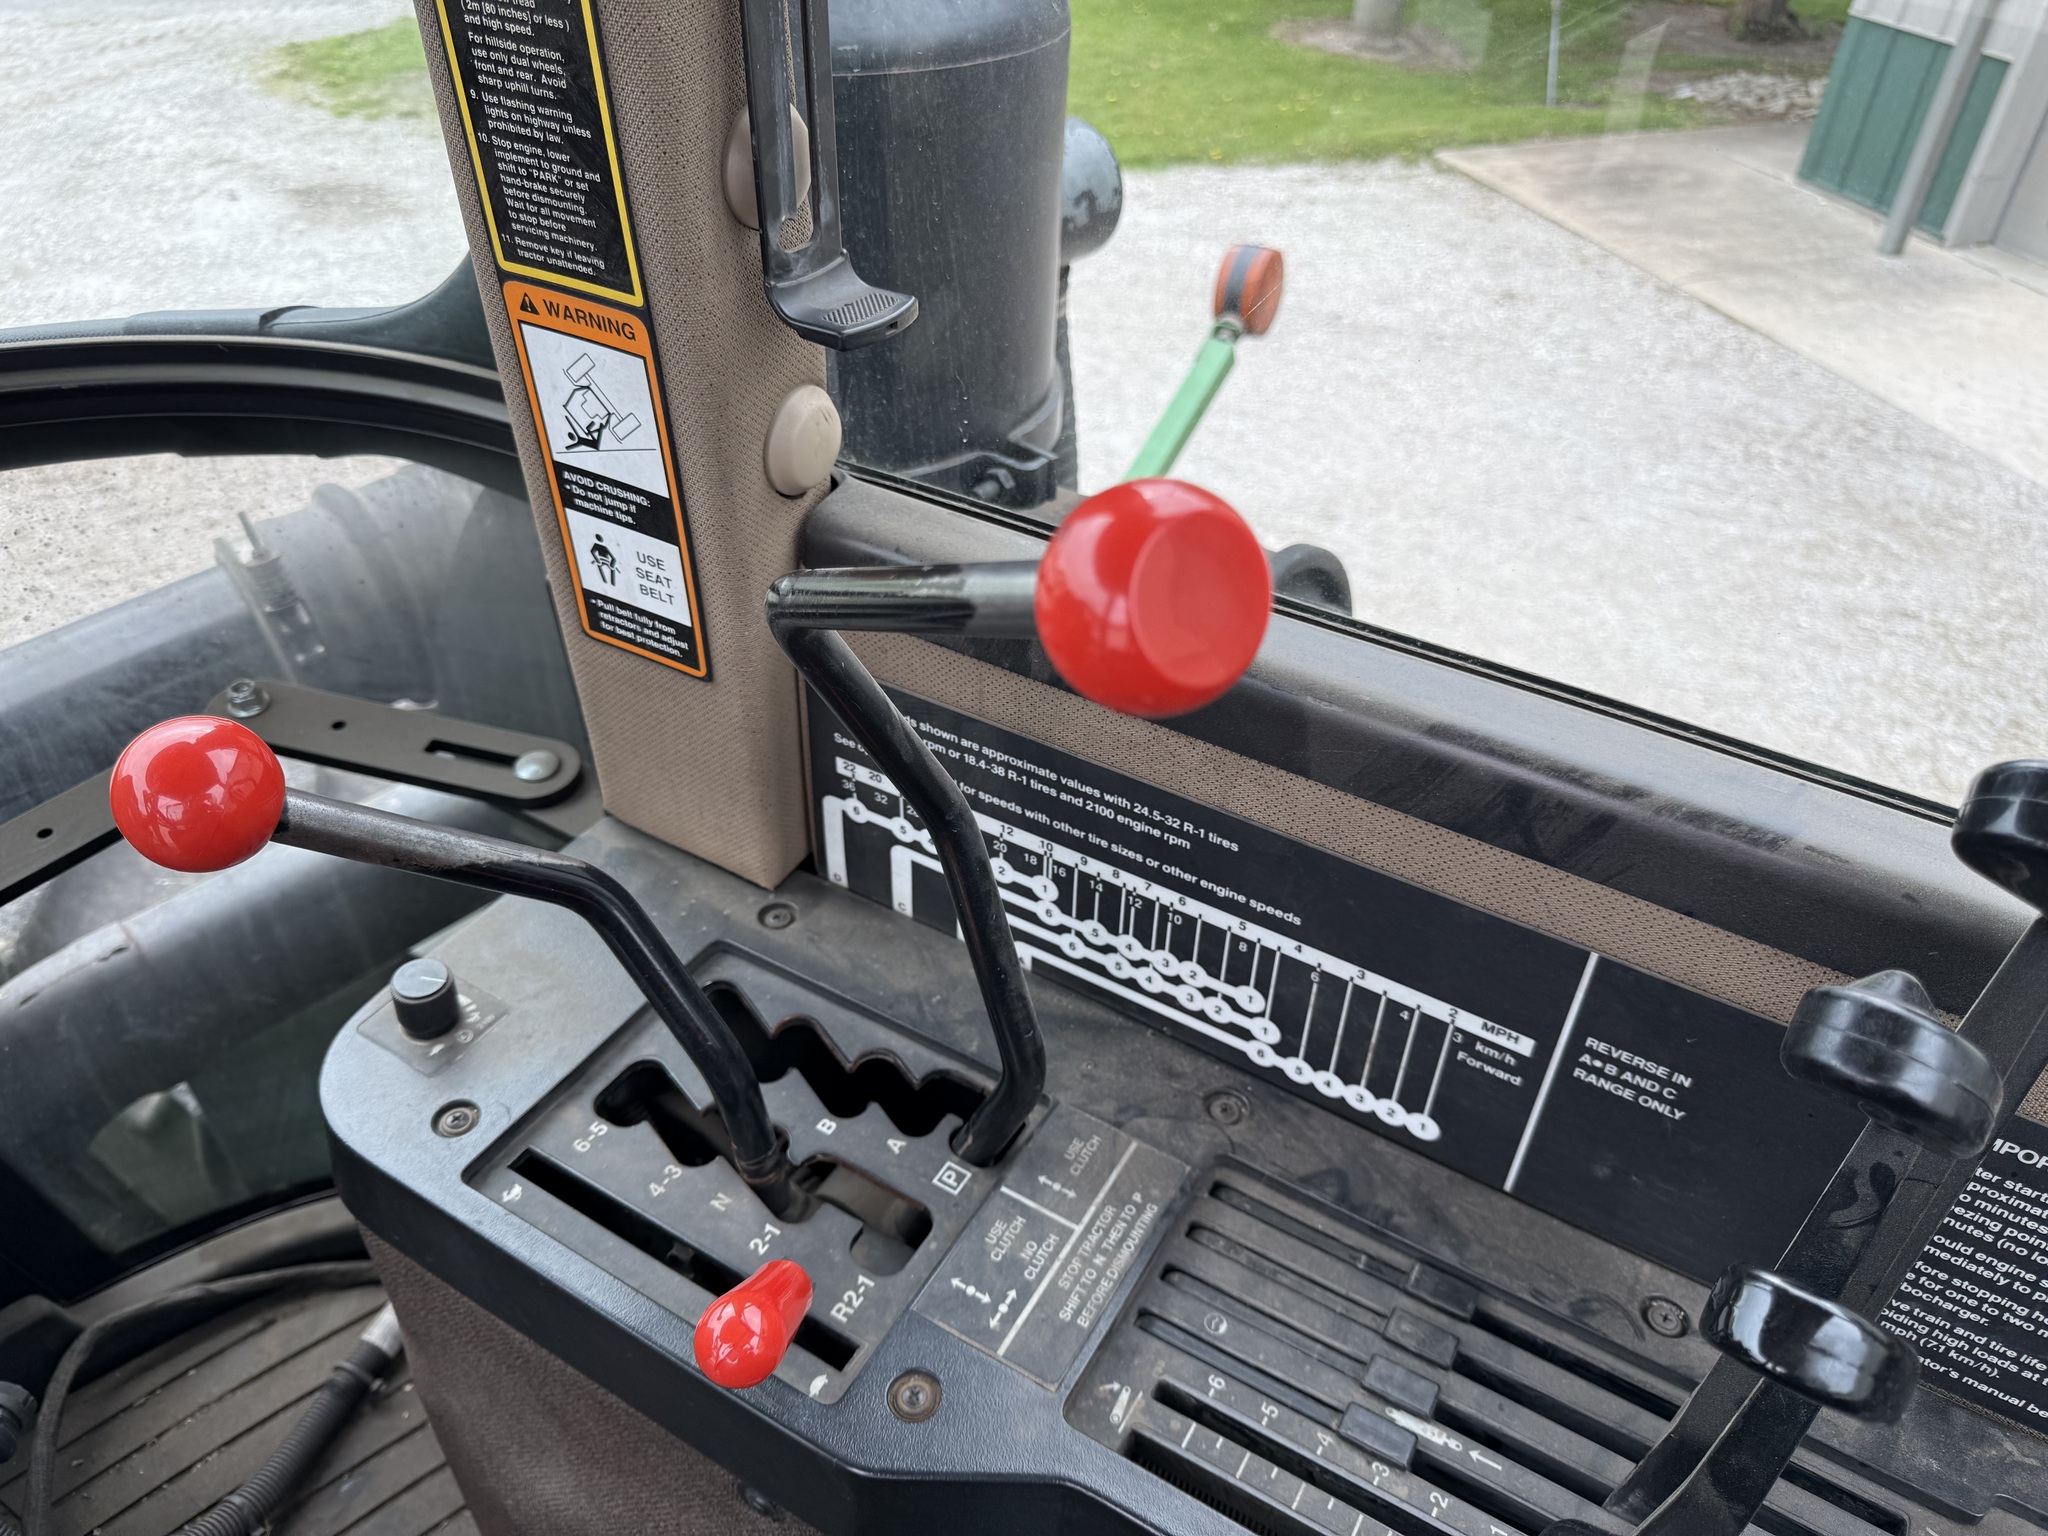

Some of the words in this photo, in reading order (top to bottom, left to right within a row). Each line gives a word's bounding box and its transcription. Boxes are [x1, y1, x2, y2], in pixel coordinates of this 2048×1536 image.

[504, 22, 534, 36] speed.
[468, 32, 483, 42] For
[485, 35, 517, 51] hillside
[520, 44, 564, 63] operation,
[531, 85, 557, 99] turns.
[542, 74, 566, 88] Avoid
[470, 89, 478, 99] 9.
[482, 92, 498, 103] Use
[500, 96, 535, 114] flashing
[537, 106, 572, 123] warning
[485, 105, 509, 119] lights
[524, 115, 559, 132] highway
[563, 125, 591, 138] unless
[488, 119, 531, 136] prohibited
[478, 132, 490, 143] 10.
[492, 135, 512, 149] Stop
[514, 142, 545, 157] engine,
[547, 149, 570, 162] lower
[500, 173, 547, 193] hand-brake
[529, 168, 561, 183] "PARK"
[505, 197, 524, 210] Wait
[552, 211, 596, 228] movement
[532, 193, 587, 215] dismounting.
[501, 234, 513, 243] 11.
[515, 236, 548, 252] Remove
[574, 252, 605, 269] leaving
[552, 232, 597, 251] machinery.
[517, 249, 545, 262] tractor
[547, 256, 596, 276] unattended.
[543, 299, 636, 341] WARNING
[563, 471, 594, 488] AVOID
[596, 481, 651, 507] CRUSHING:
[572, 486, 586, 497] Do
[588, 490, 603, 502] not
[605, 494, 628, 513] jump
[630, 503, 637, 513] if
[575, 498, 614, 518] machine
[616, 510, 636, 524] tips.
[636, 551, 665, 571] USE
[635, 567, 672, 589] SEAT
[639, 584, 675, 605] BELT
[597, 599, 614, 613] Pull
[616, 605, 633, 619] belt
[634, 612, 653, 627] fully
[655, 620, 676, 635] from
[598, 612, 642, 632] retractors
[644, 628, 660, 638] and
[662, 633, 689, 650] adjust
[602, 622, 614, 632] for
[615, 625, 634, 639] best
[637, 635, 683, 657] protection.
[919, 723, 958, 743] shown
[960, 736, 979, 751] are
[981, 746, 1058, 781] approximate
[1060, 774, 1101, 798] values
[1103, 790, 1132, 810] with
[1133, 802, 1181, 830] 24.5-32
[1183, 819, 1205, 837] R-1
[1208, 828, 1239, 852] tires
[948, 749, 961, 759] or
[963, 752, 1005, 777] 18.4-38
[1008, 768, 1028, 786] R-1
[1030, 778, 1058, 797] tires
[1060, 790, 1083, 808] and
[1085, 798, 1115, 820] 2100
[1117, 810, 1161, 840] engine
[1163, 828, 1191, 850] rpm
[834, 732, 855, 750] See
[960, 779, 976, 795] for
[978, 790, 1022, 815] speeds
[1024, 808, 1050, 826] with
[1053, 816, 1086, 840] other
[1088, 830, 1108, 848] tire
[1110, 838, 1143, 864] sizes
[1146, 855, 1160, 868] or
[1162, 859, 1198, 884] other
[1200, 876, 1246, 906] engine
[1250, 895, 1302, 926] speeds
[843, 761, 856, 772] 22
[869, 771, 882, 783] 20
[1001, 825, 1014, 836] 12
[1040, 840, 1053, 850] 10
[1481, 1021, 1520, 1045] MPH
[842, 779, 856, 792] 36
[874, 793, 888, 804] 32
[993, 840, 1007, 852] 20
[1024, 853, 1037, 865] 18
[1053, 865, 1066, 877] 16
[1089, 880, 1103, 892] 14
[1128, 896, 1142, 908] 12
[1168, 913, 1182, 925] 10
[1474, 1040, 1516, 1067] km/h
[1457, 1051, 1522, 1086] Forward
[1585, 1036, 1669, 1079] REVERSE
[1672, 1073, 1692, 1088] IN
[1572, 1067, 1639, 1105] RANGE
[1639, 1095, 1687, 1121] ONLY
[1620, 1067, 1659, 1093] AND
[1663, 1086, 1677, 1099] C
[573, 1121, 609, 1154] 6-5
[817, 1118, 837, 1136] B
[886, 1137, 907, 1154] A
[1065, 1137, 1084, 1160] USE
[1069, 1135, 1102, 1176] CLUTCH
[647, 1164, 683, 1198] 4-3
[709, 1192, 733, 1212] N
[749, 1223, 782, 1256] 2-1
[985, 1219, 1007, 1245] USE
[990, 1216, 1027, 1262] CLUTCH
[1058, 1256, 1082, 1290] STOP
[1079, 1204, 1117, 1258] TRACTOR
[1997, 1238, 2028, 1255] (no
[1020, 1241, 1038, 1262] NO
[1024, 1234, 1060, 1281] CLUTCH
[1059, 1285, 1086, 1322] SHIFT
[1082, 1269, 1097, 1288] TO
[1094, 1254, 1106, 1267] N
[1102, 1226, 1127, 1255] THEN
[1122, 1204, 1137, 1228] TO
[1133, 1192, 1142, 1206] P
[1077, 1277, 1113, 1328] BEFORE
[1107, 1203, 1158, 1279] DISMOUNTING
[1975, 1252, 2036, 1282] engine
[830, 1274, 876, 1323] R2-1
[1919, 1276, 1943, 1291] for
[1945, 1289, 1978, 1307] one
[1981, 1302, 1999, 1316] to
[2002, 1312, 2035, 1331] two
[1951, 1278, 2030, 1316] stopping
[2012, 1281, 2031, 1294] to
[1880, 1320, 1917, 1342] mph
[1948, 1350, 2000, 1379] km/h).
[1914, 1307, 1951, 1329] train
[1953, 1327, 1988, 1344] and
[1989, 1340, 2018, 1358] tire
[2020, 1354, 2047, 1371] life
[1932, 1329, 1970, 1351] high
[1972, 1347, 2019, 1372] loads
[2021, 1370, 2041, 1382] at
[1962, 1376, 2026, 1407] manual
